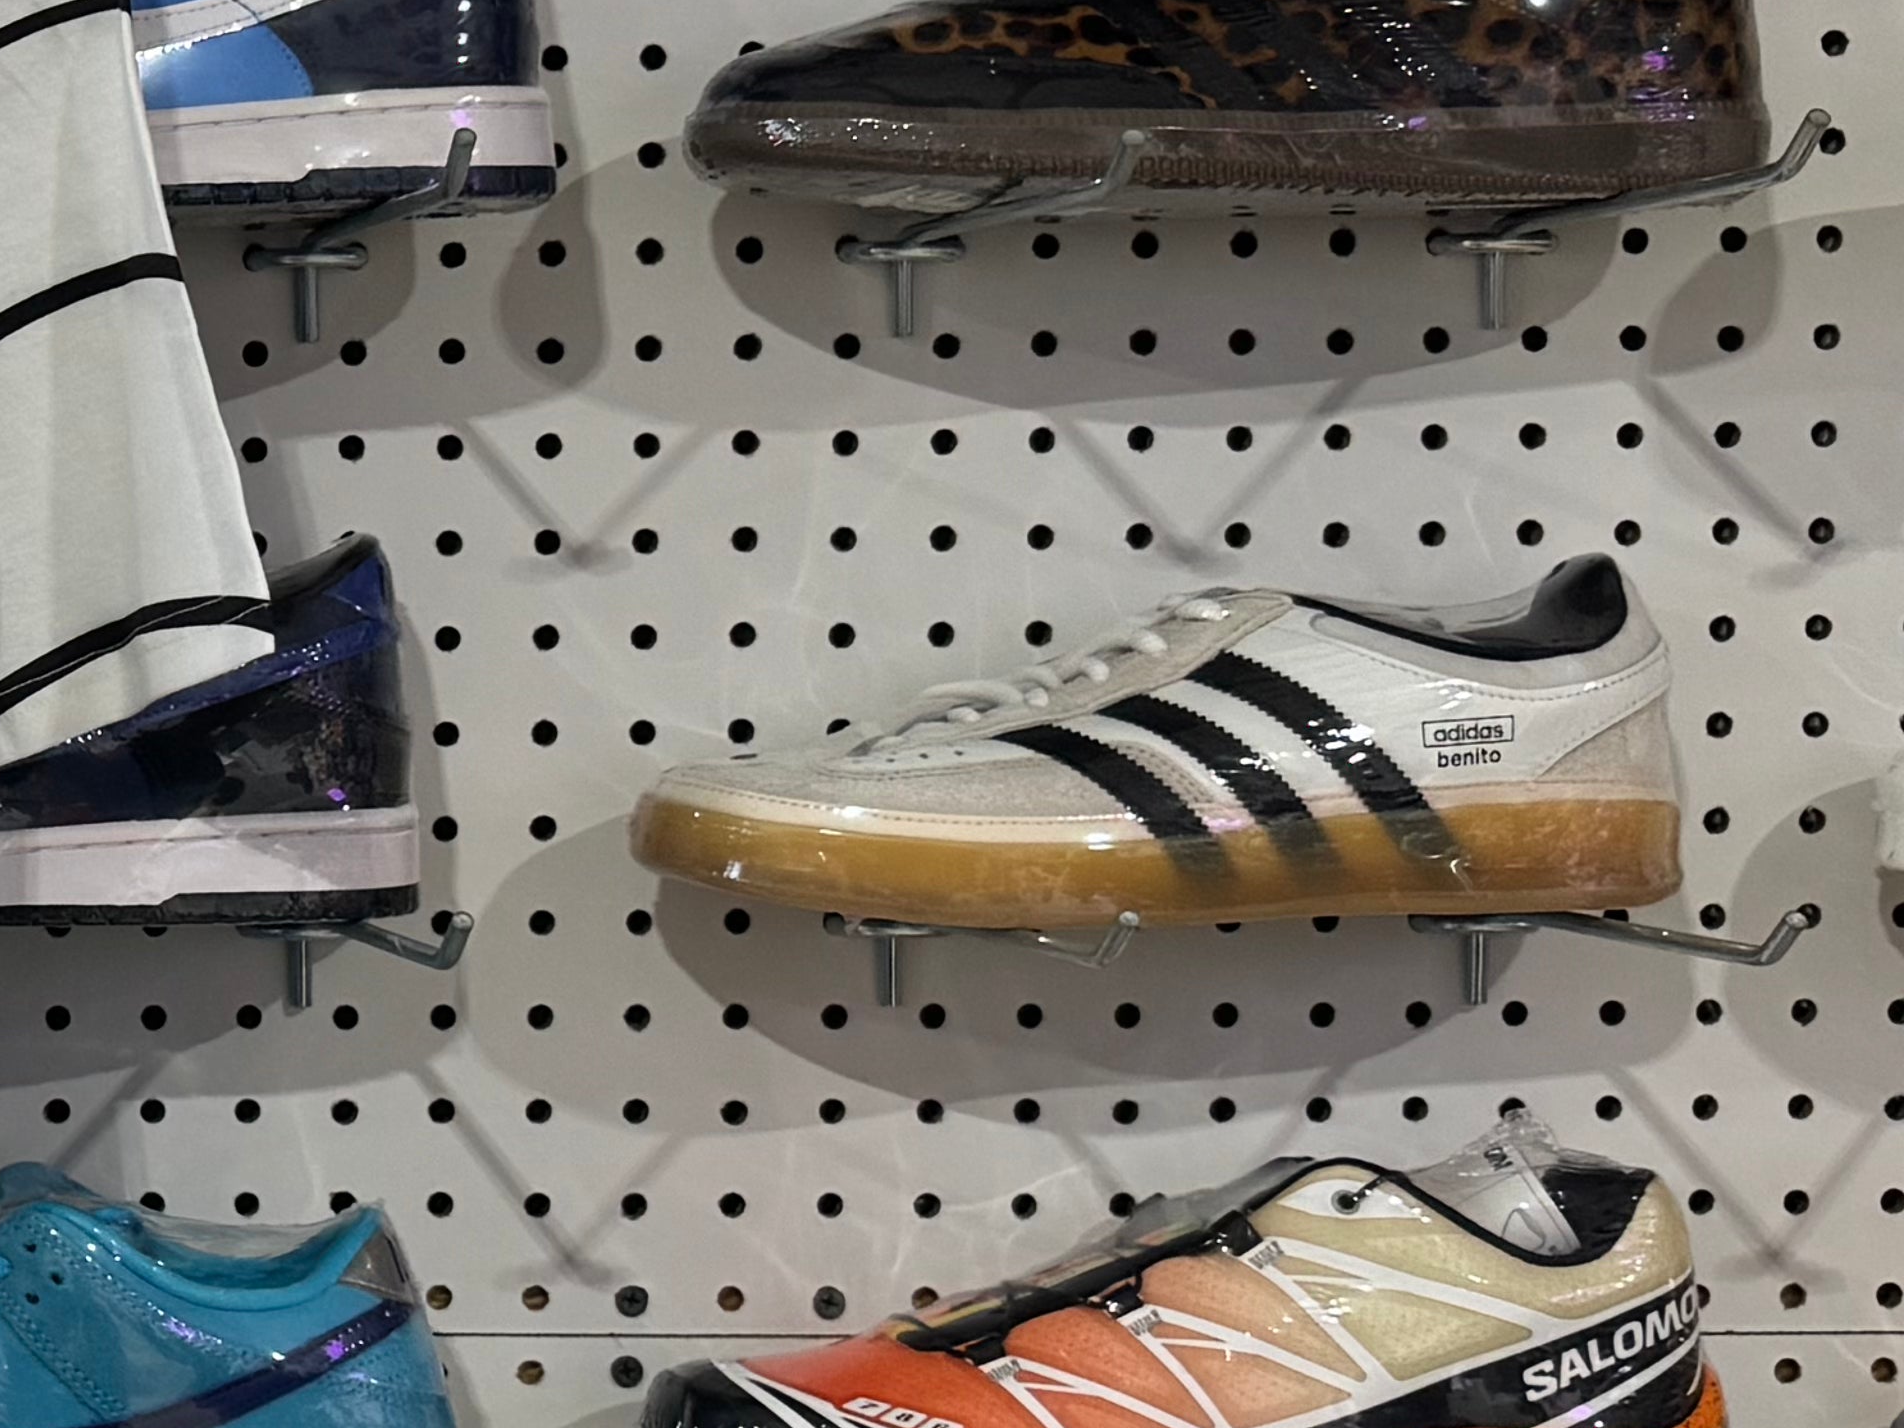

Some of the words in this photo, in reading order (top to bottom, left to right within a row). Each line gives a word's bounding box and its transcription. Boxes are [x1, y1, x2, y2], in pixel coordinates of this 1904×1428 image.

[1433, 723, 1505, 742] adidas
[1437, 748, 1502, 768] benito
[1522, 1284, 1698, 1403] SALOMO
